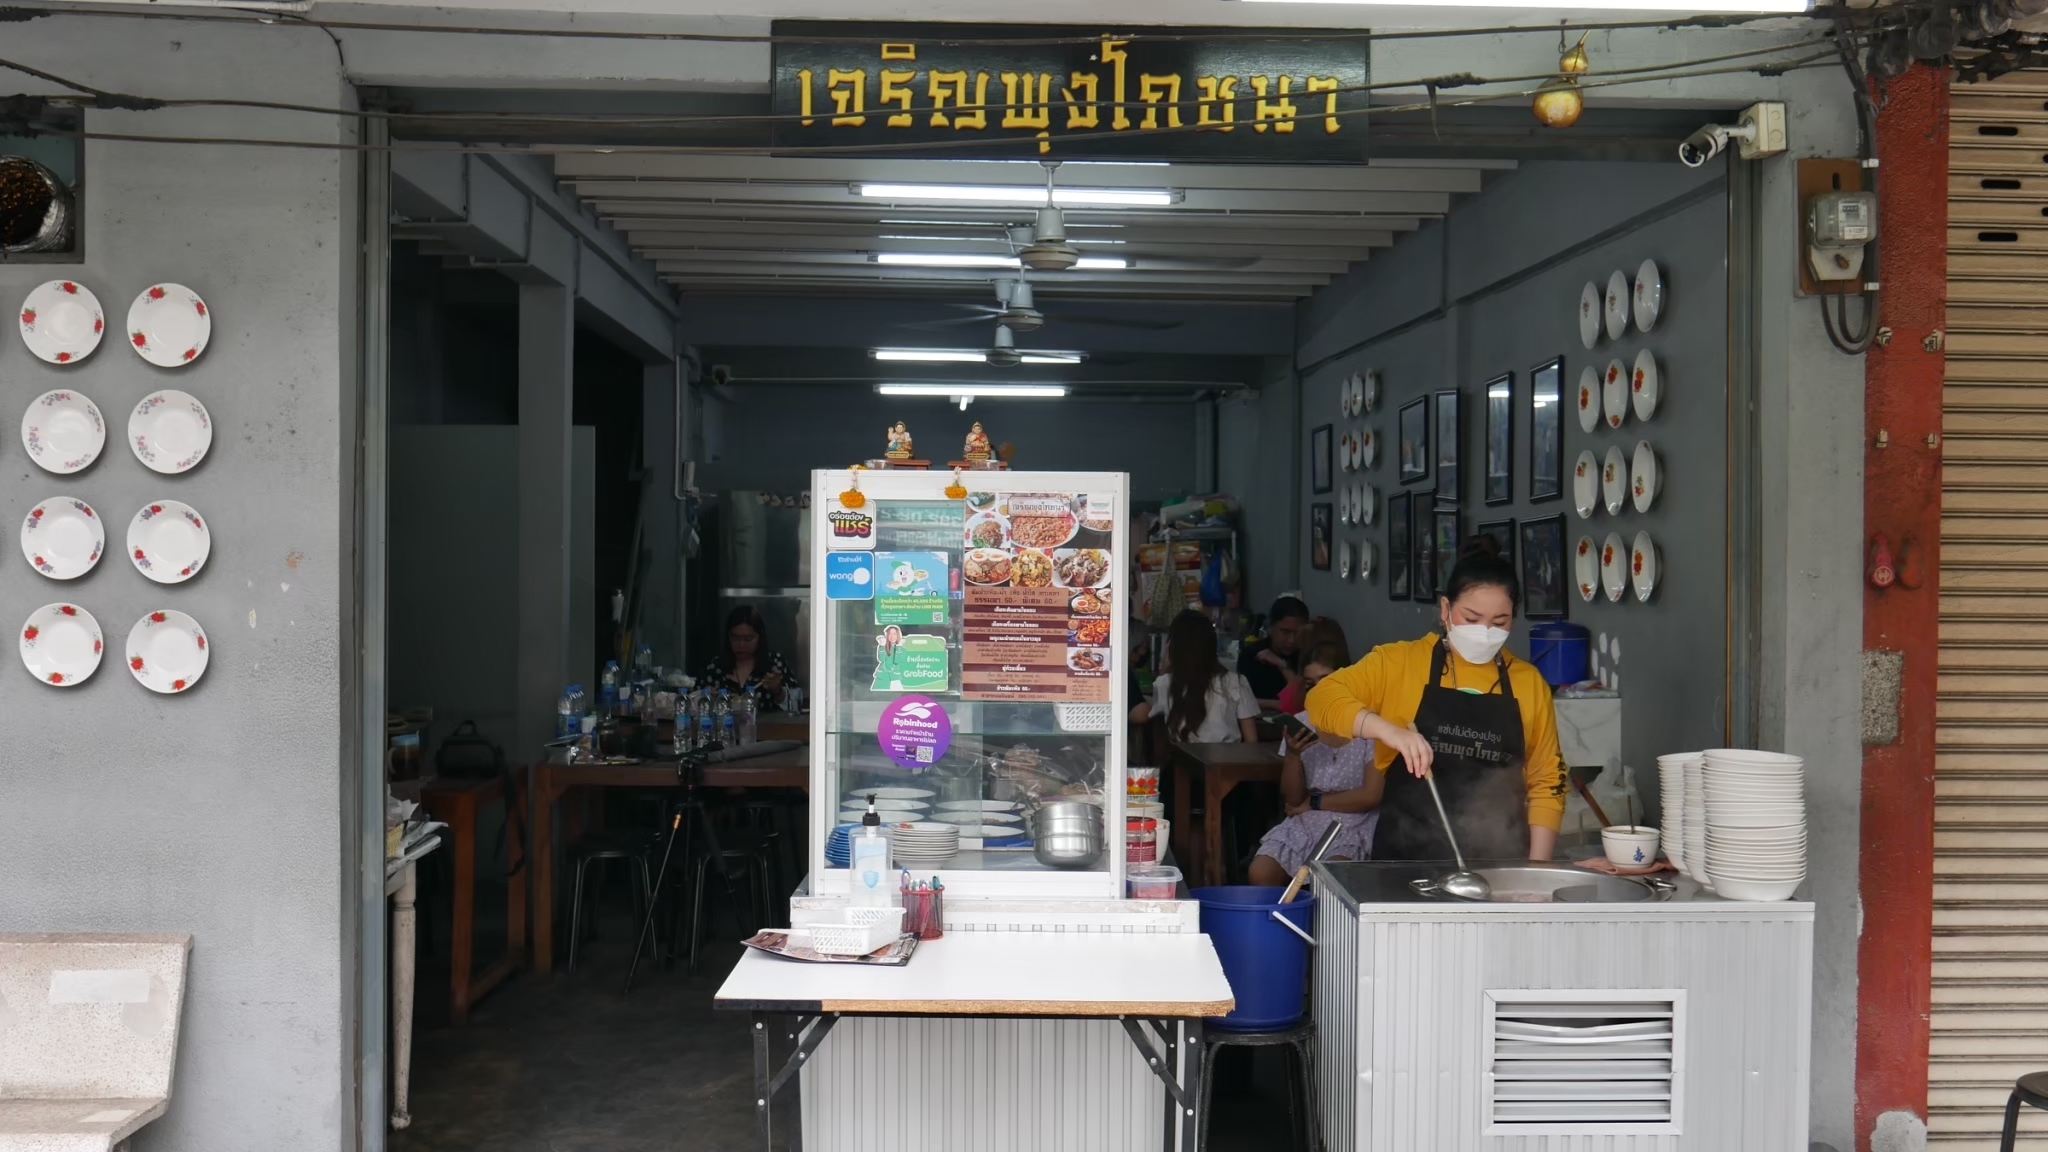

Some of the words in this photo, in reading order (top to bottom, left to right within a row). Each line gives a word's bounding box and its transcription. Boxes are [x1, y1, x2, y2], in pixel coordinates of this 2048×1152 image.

[797, 33, 1341, 154] เจริญพุงโภชนา
[829, 511, 864, 521] อร่อยต้อง
[835, 518, 871, 535] แชร์
[903, 669, 944, 678] GrabFood
[893, 717, 938, 729] Robinhood
